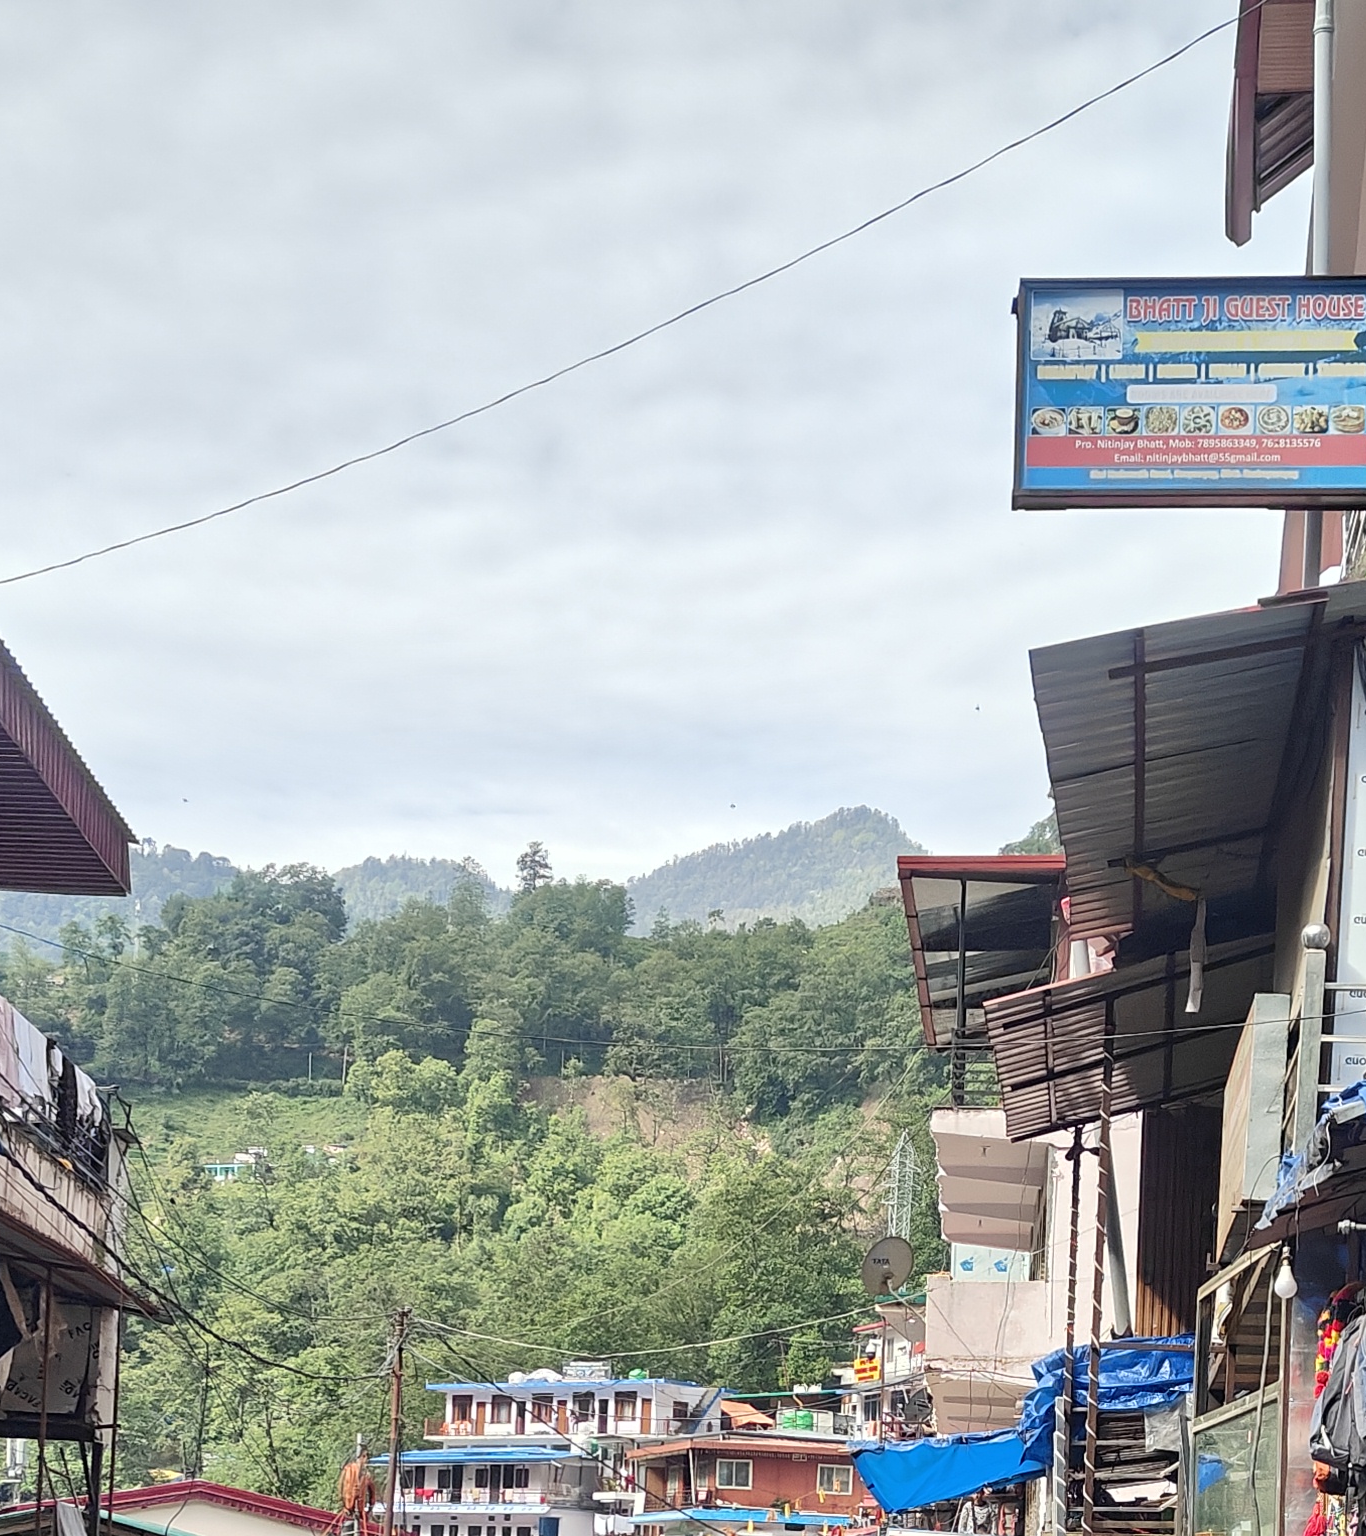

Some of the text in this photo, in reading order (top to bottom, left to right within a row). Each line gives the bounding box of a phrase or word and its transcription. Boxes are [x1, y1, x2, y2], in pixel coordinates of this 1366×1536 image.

[1127, 295, 1366, 325] BHATT JI GUEST HOUSE
[1076, 440, 1095, 449] Pro.
[1097, 439, 1134, 450] Nitinjay
[1137, 439, 1166, 450] Bhatt,
[1169, 439, 1195, 449] Mob:
[1114, 453, 1144, 464] Email:
